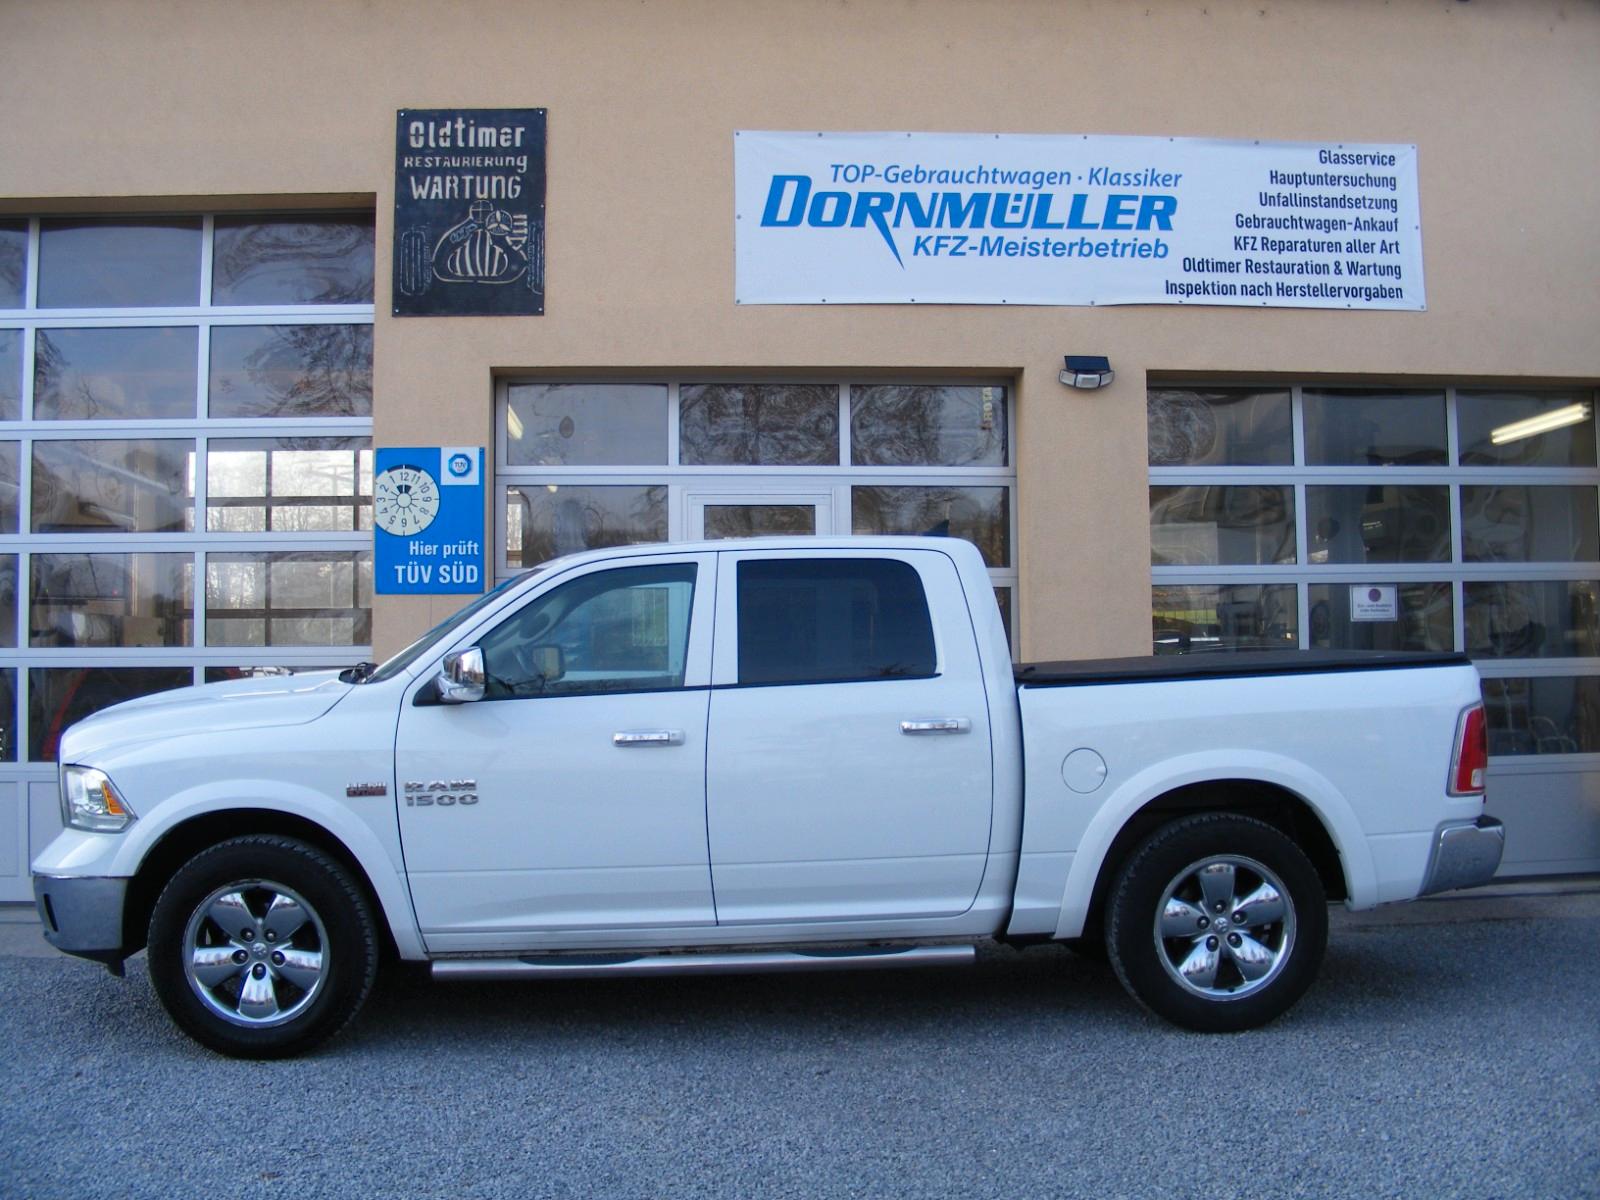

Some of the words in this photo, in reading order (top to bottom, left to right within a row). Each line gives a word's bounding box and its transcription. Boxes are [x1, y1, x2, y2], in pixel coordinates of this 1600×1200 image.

[410, 117, 525, 148] Oldtimer
[1319, 150, 1395, 166] Glasservice
[831, 164, 1071, 187] TOP-Gebrauchtwagen
[1088, 167, 1182, 187] Klassiker
[1270, 170, 1396, 191] Hauptuntersuchung
[1259, 192, 1397, 213] Unfallinstandsetzung
[1236, 213, 1398, 233] Gebrauchtwagen-Ankauf
[913, 235, 1169, 258] KFZ-Meisterbetrieb
[1234, 236, 1257, 251] KFZ
[1261, 237, 1342, 255] Reparaturen
[1346, 239, 1376, 254] aller
[1380, 240, 1400, 254] Art
[1183, 257, 1241, 274] Oldtimer
[1245, 259, 1330, 275] Restauration
[1334, 261, 1343, 275] &
[1347, 262, 1402, 280] Wartung
[1165, 280, 1237, 298] Inspektion
[1241, 282, 1273, 296] nach
[1276, 282, 1403, 301] Herstellervorgaben
[400, 472, 409, 481] 12
[410, 541, 438, 555] Hier
[443, 541, 479, 558] prüft
[395, 561, 432, 583] TÜV
[439, 561, 478, 583] SÜD
[405, 794, 479, 807] 1500
